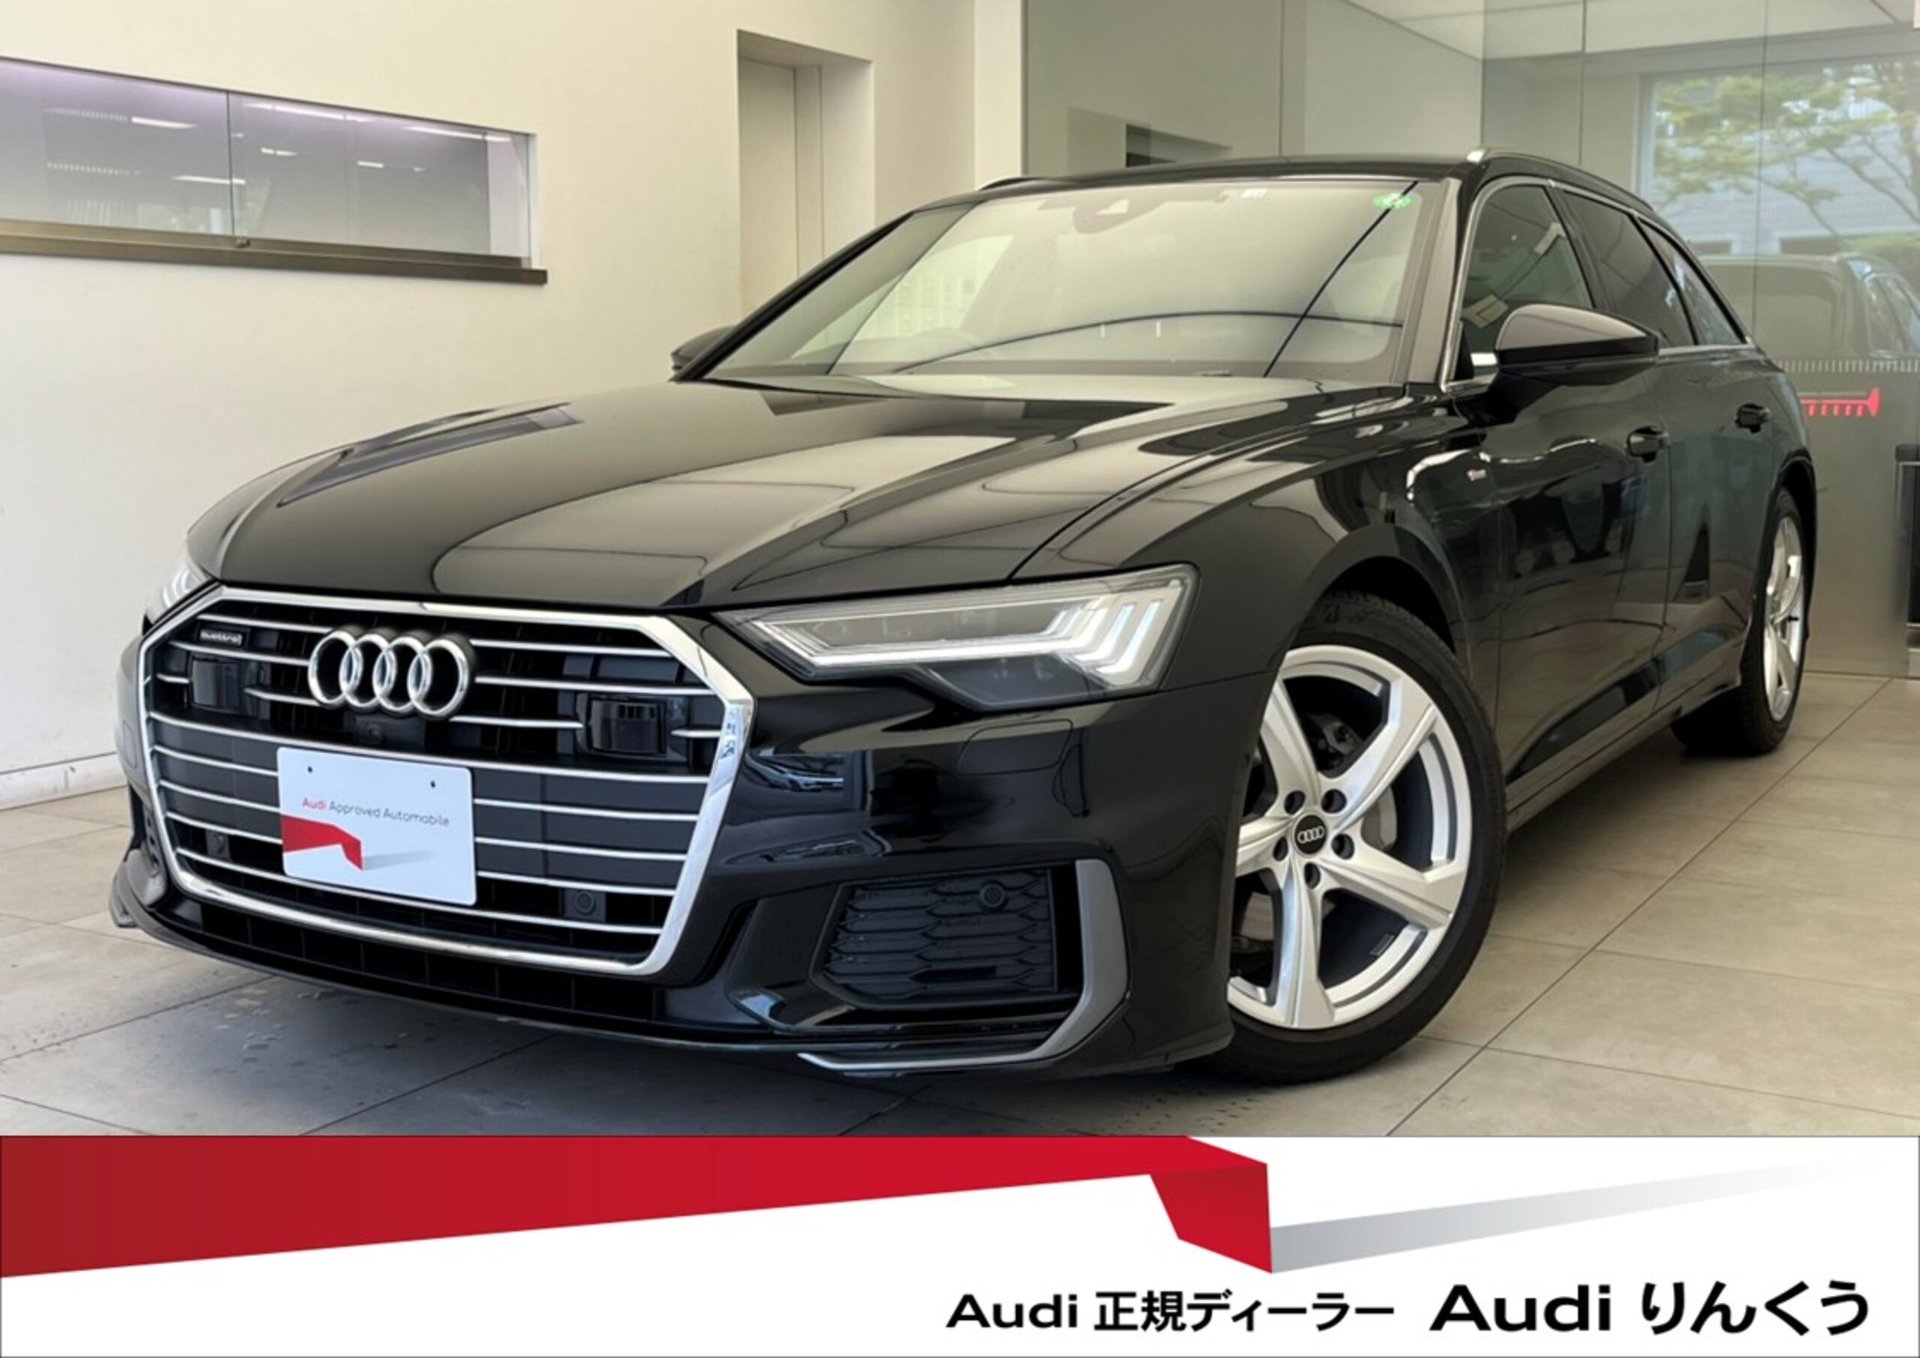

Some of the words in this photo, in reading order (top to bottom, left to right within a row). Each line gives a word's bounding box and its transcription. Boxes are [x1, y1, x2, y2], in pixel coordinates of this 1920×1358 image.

[302, 797, 327, 811] Audi
[329, 801, 381, 818] Approved
[383, 808, 450, 827] Automobile
